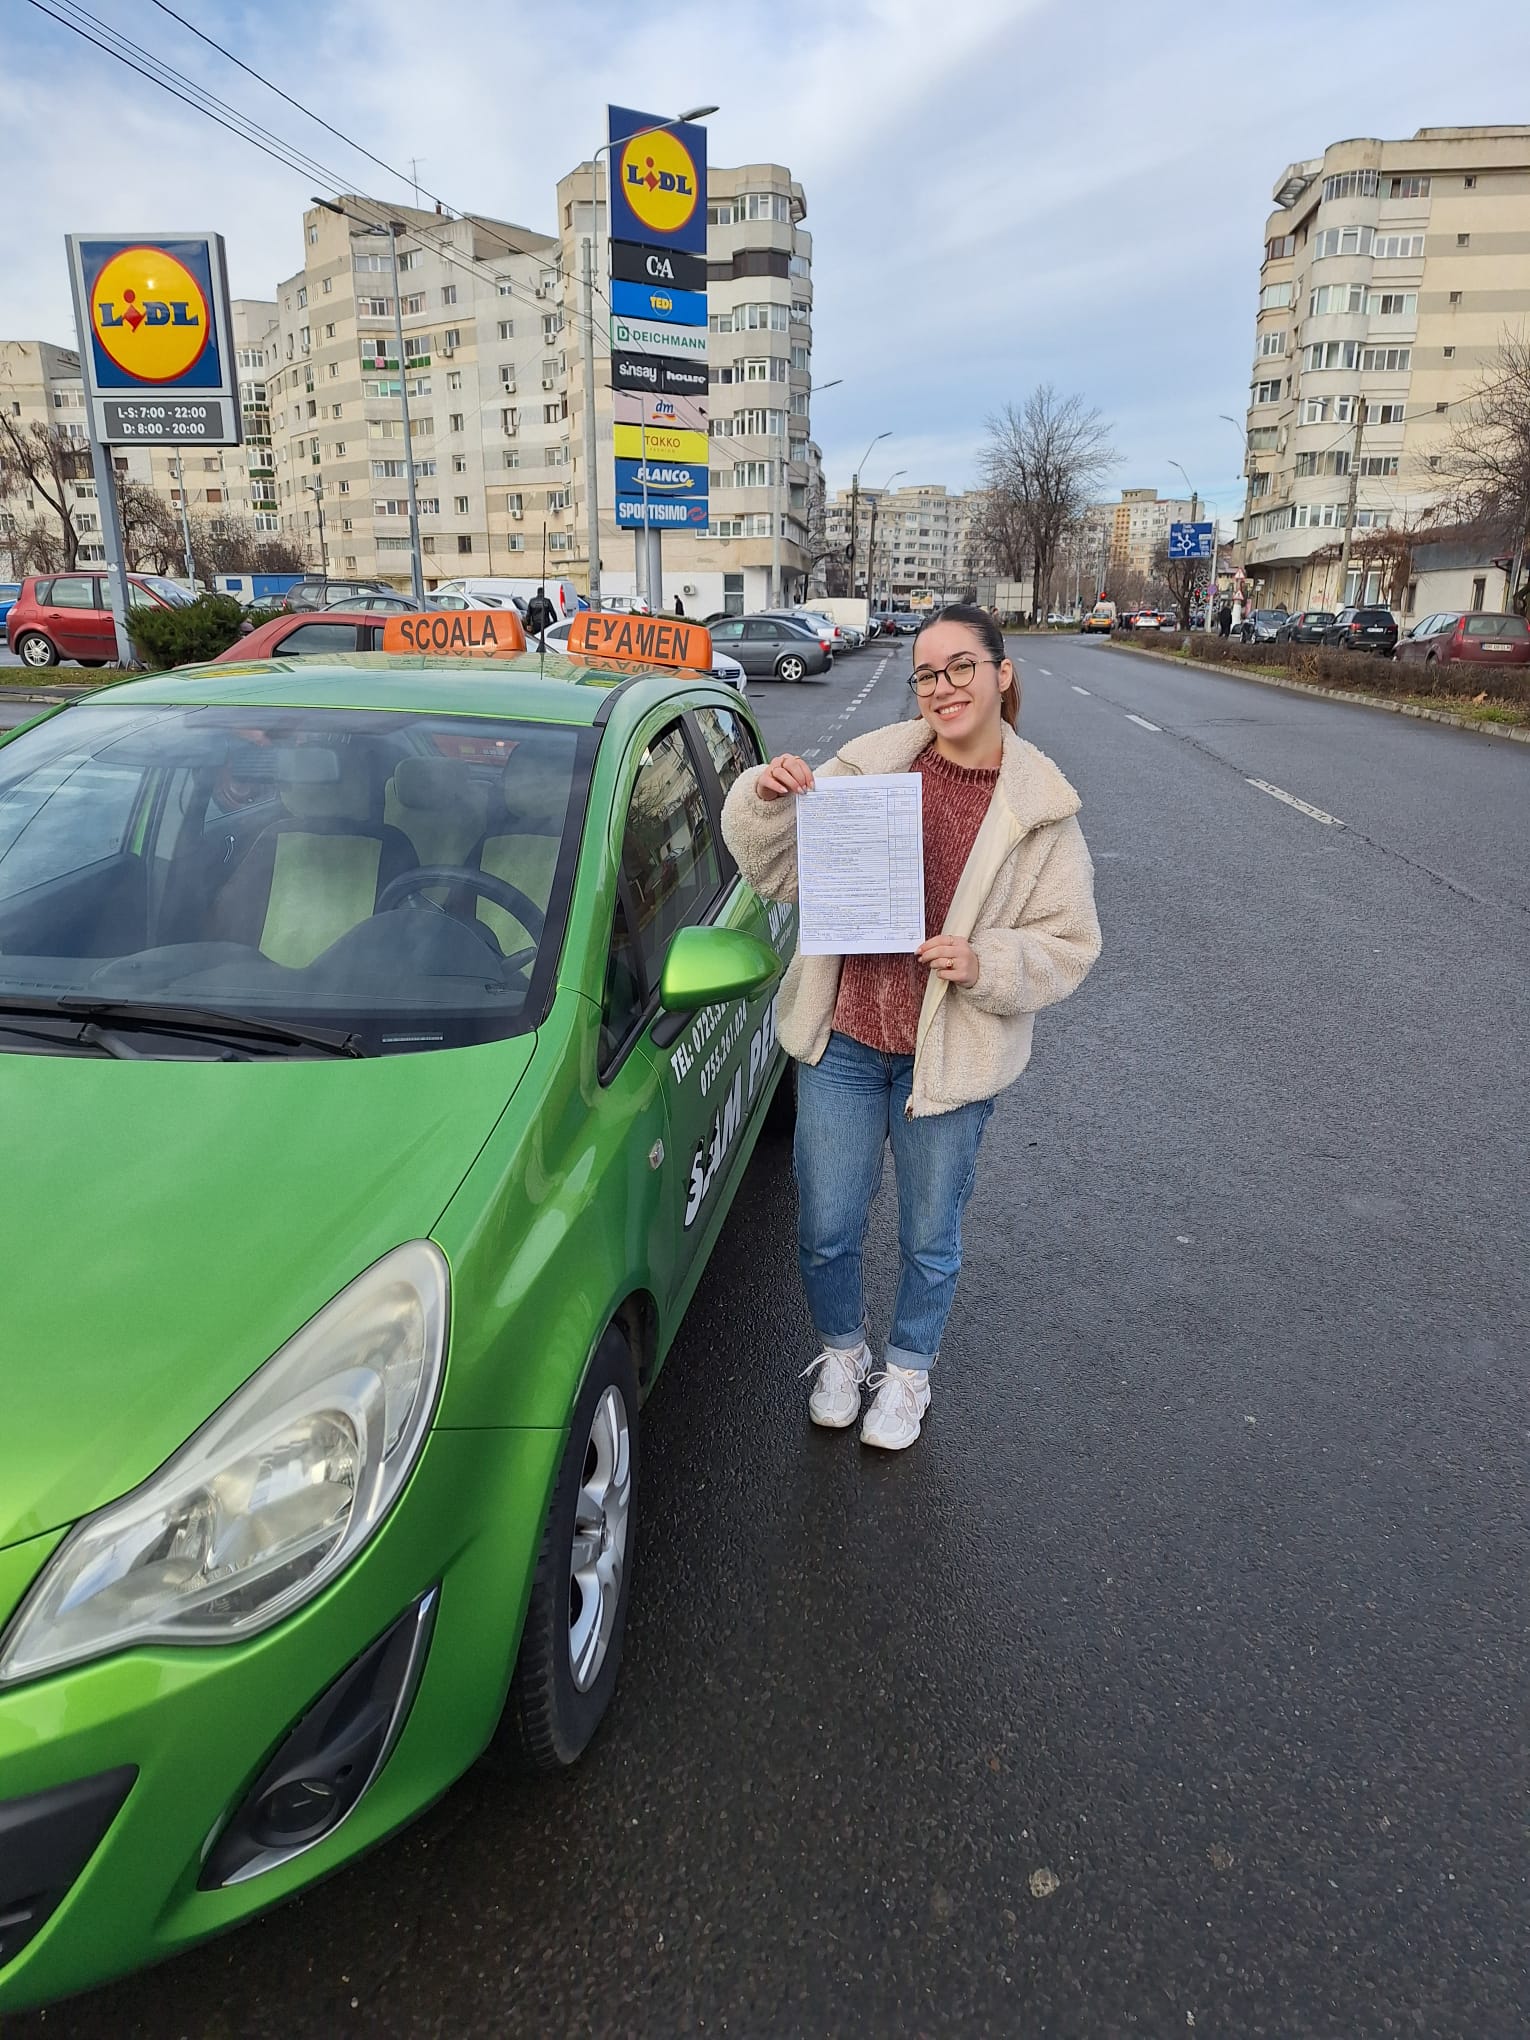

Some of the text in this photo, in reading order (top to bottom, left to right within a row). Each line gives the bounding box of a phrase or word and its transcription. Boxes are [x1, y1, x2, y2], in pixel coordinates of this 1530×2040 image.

[646, 255, 675, 279] C&A
[633, 330, 706, 350] DEICHMANN
[619, 361, 657, 383] sinsay
[118, 407, 138, 419] L-S:
[140, 407, 165, 419] 7:00
[174, 407, 206, 418] 22:00
[656, 399, 674, 413] dm
[122, 423, 136, 435] D:
[138, 423, 163, 435] 8:00
[172, 423, 205, 434] 20:00
[637, 467, 690, 483] FLANCO
[401, 614, 498, 650] SCOALA
[584, 617, 690, 661] EXAMEN
[700, 998, 747, 1097] 0755.261.024
[670, 1042, 694, 1085] TEL:
[684, 1064, 743, 1227] SAM
